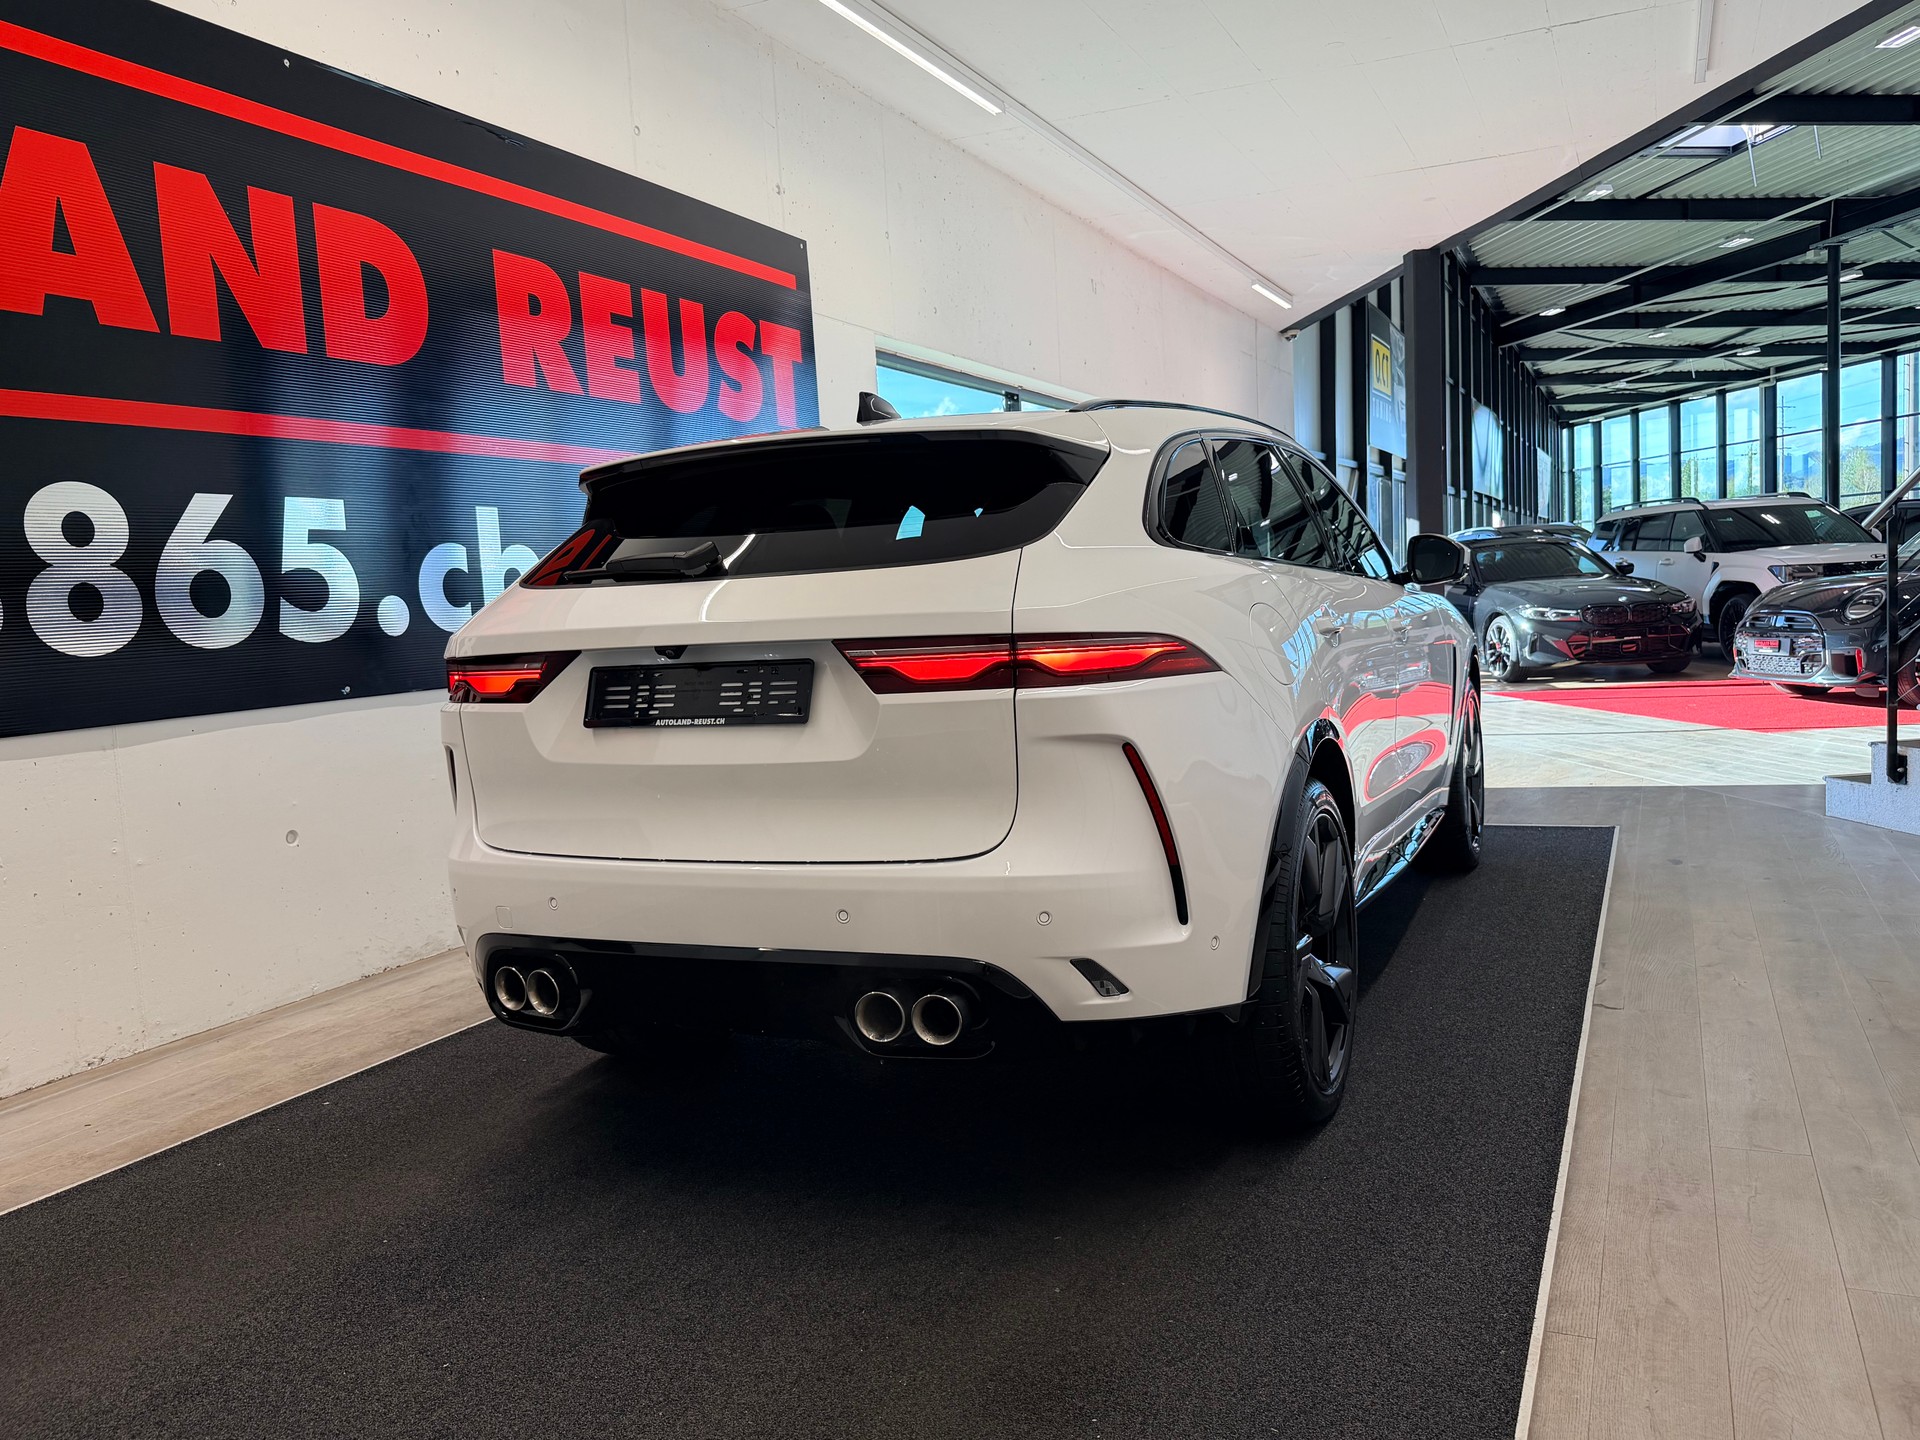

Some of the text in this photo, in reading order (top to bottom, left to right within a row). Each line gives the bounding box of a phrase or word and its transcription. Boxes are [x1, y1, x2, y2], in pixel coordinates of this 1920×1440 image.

[492, 248, 803, 429] REUST
[0, 480, 541, 658] 865.ch
[655, 717, 726, 726] AUTOLAND-REUST.CH
